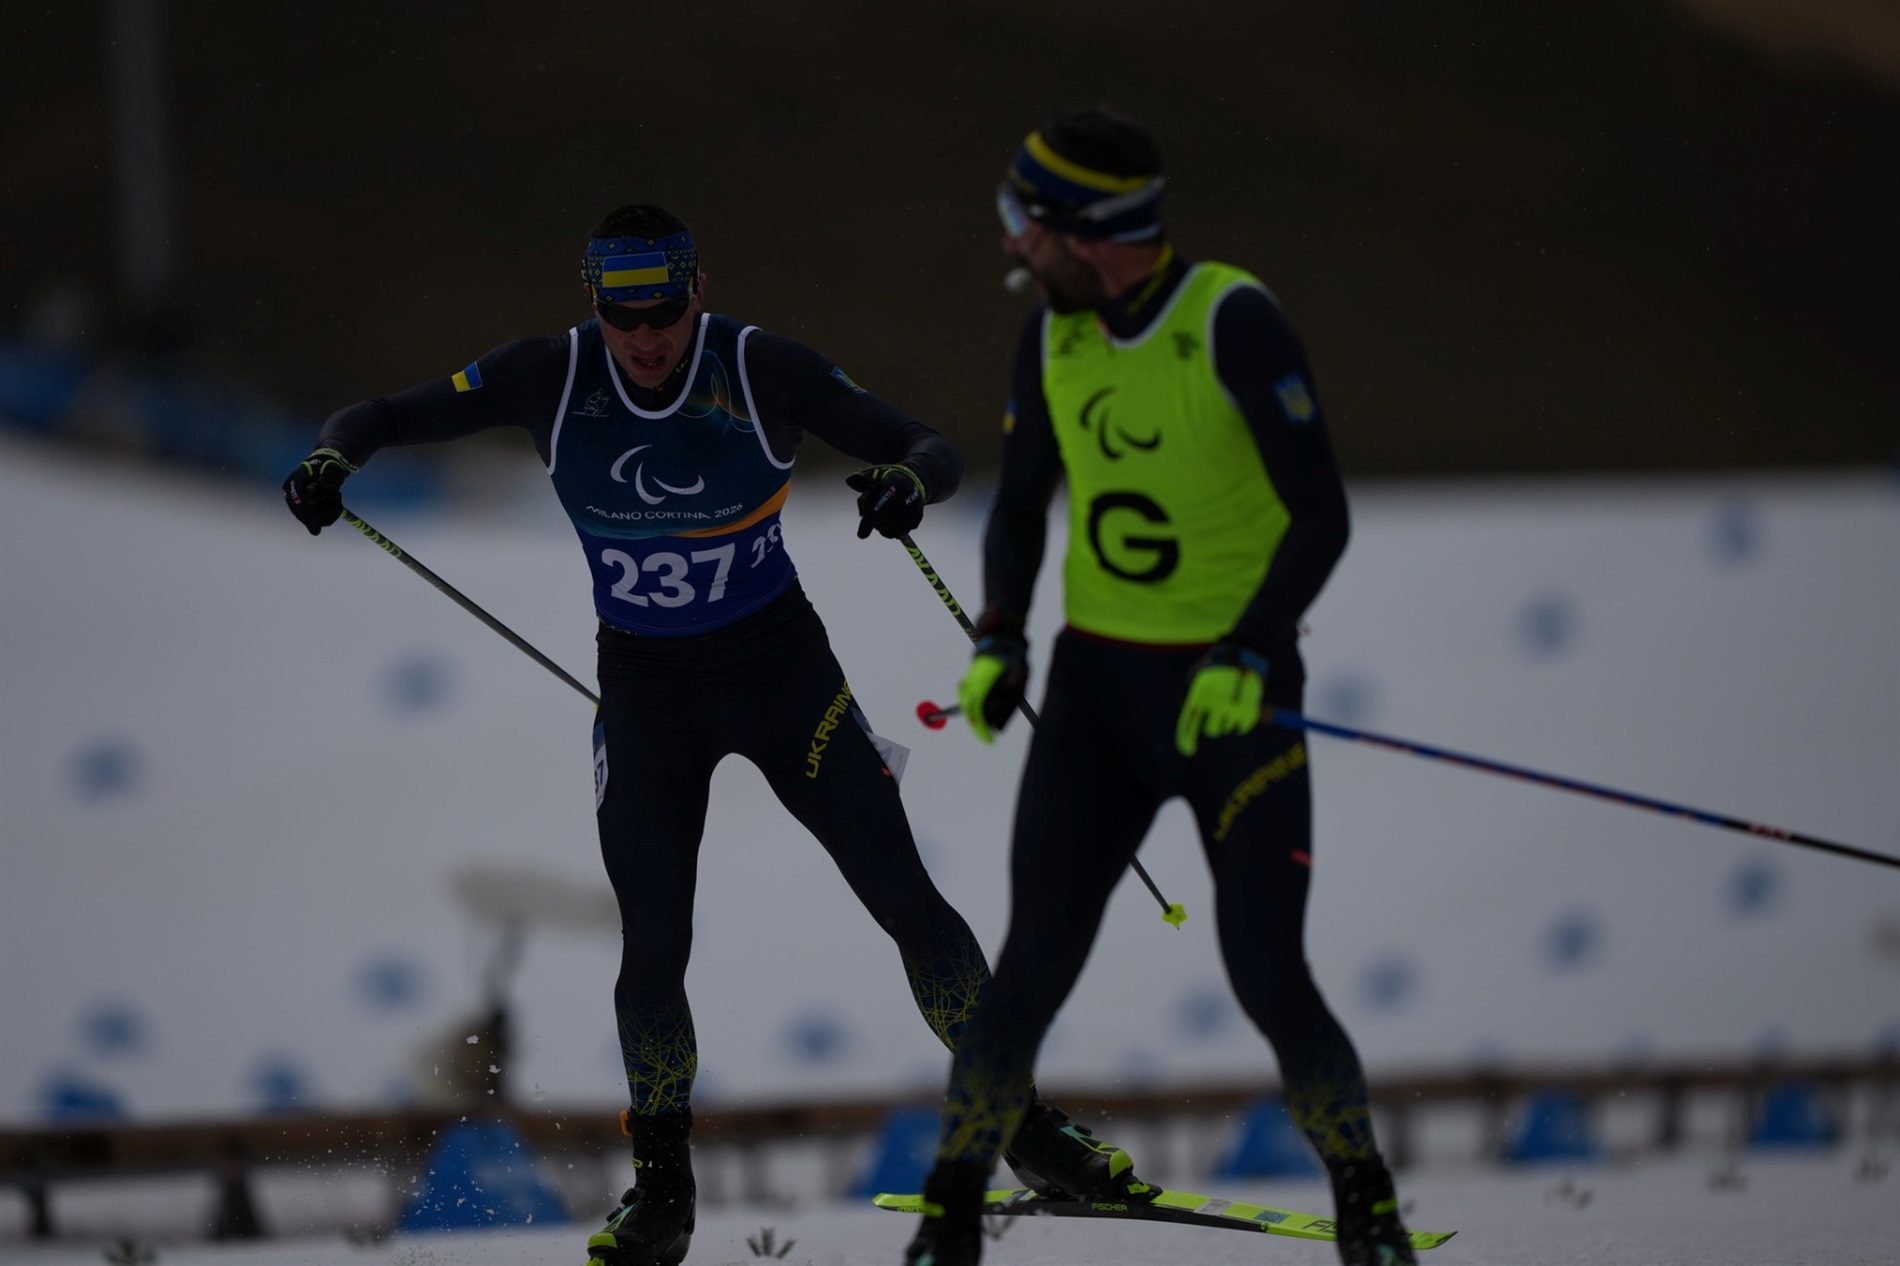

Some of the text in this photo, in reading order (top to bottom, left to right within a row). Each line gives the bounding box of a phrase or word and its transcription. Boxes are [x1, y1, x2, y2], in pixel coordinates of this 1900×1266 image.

[586, 502, 743, 521] MILANO CORTINA 2026
[1089, 490, 1179, 583] G
[601, 542, 736, 609] 237
[1091, 1202, 1129, 1212] FISCHER
